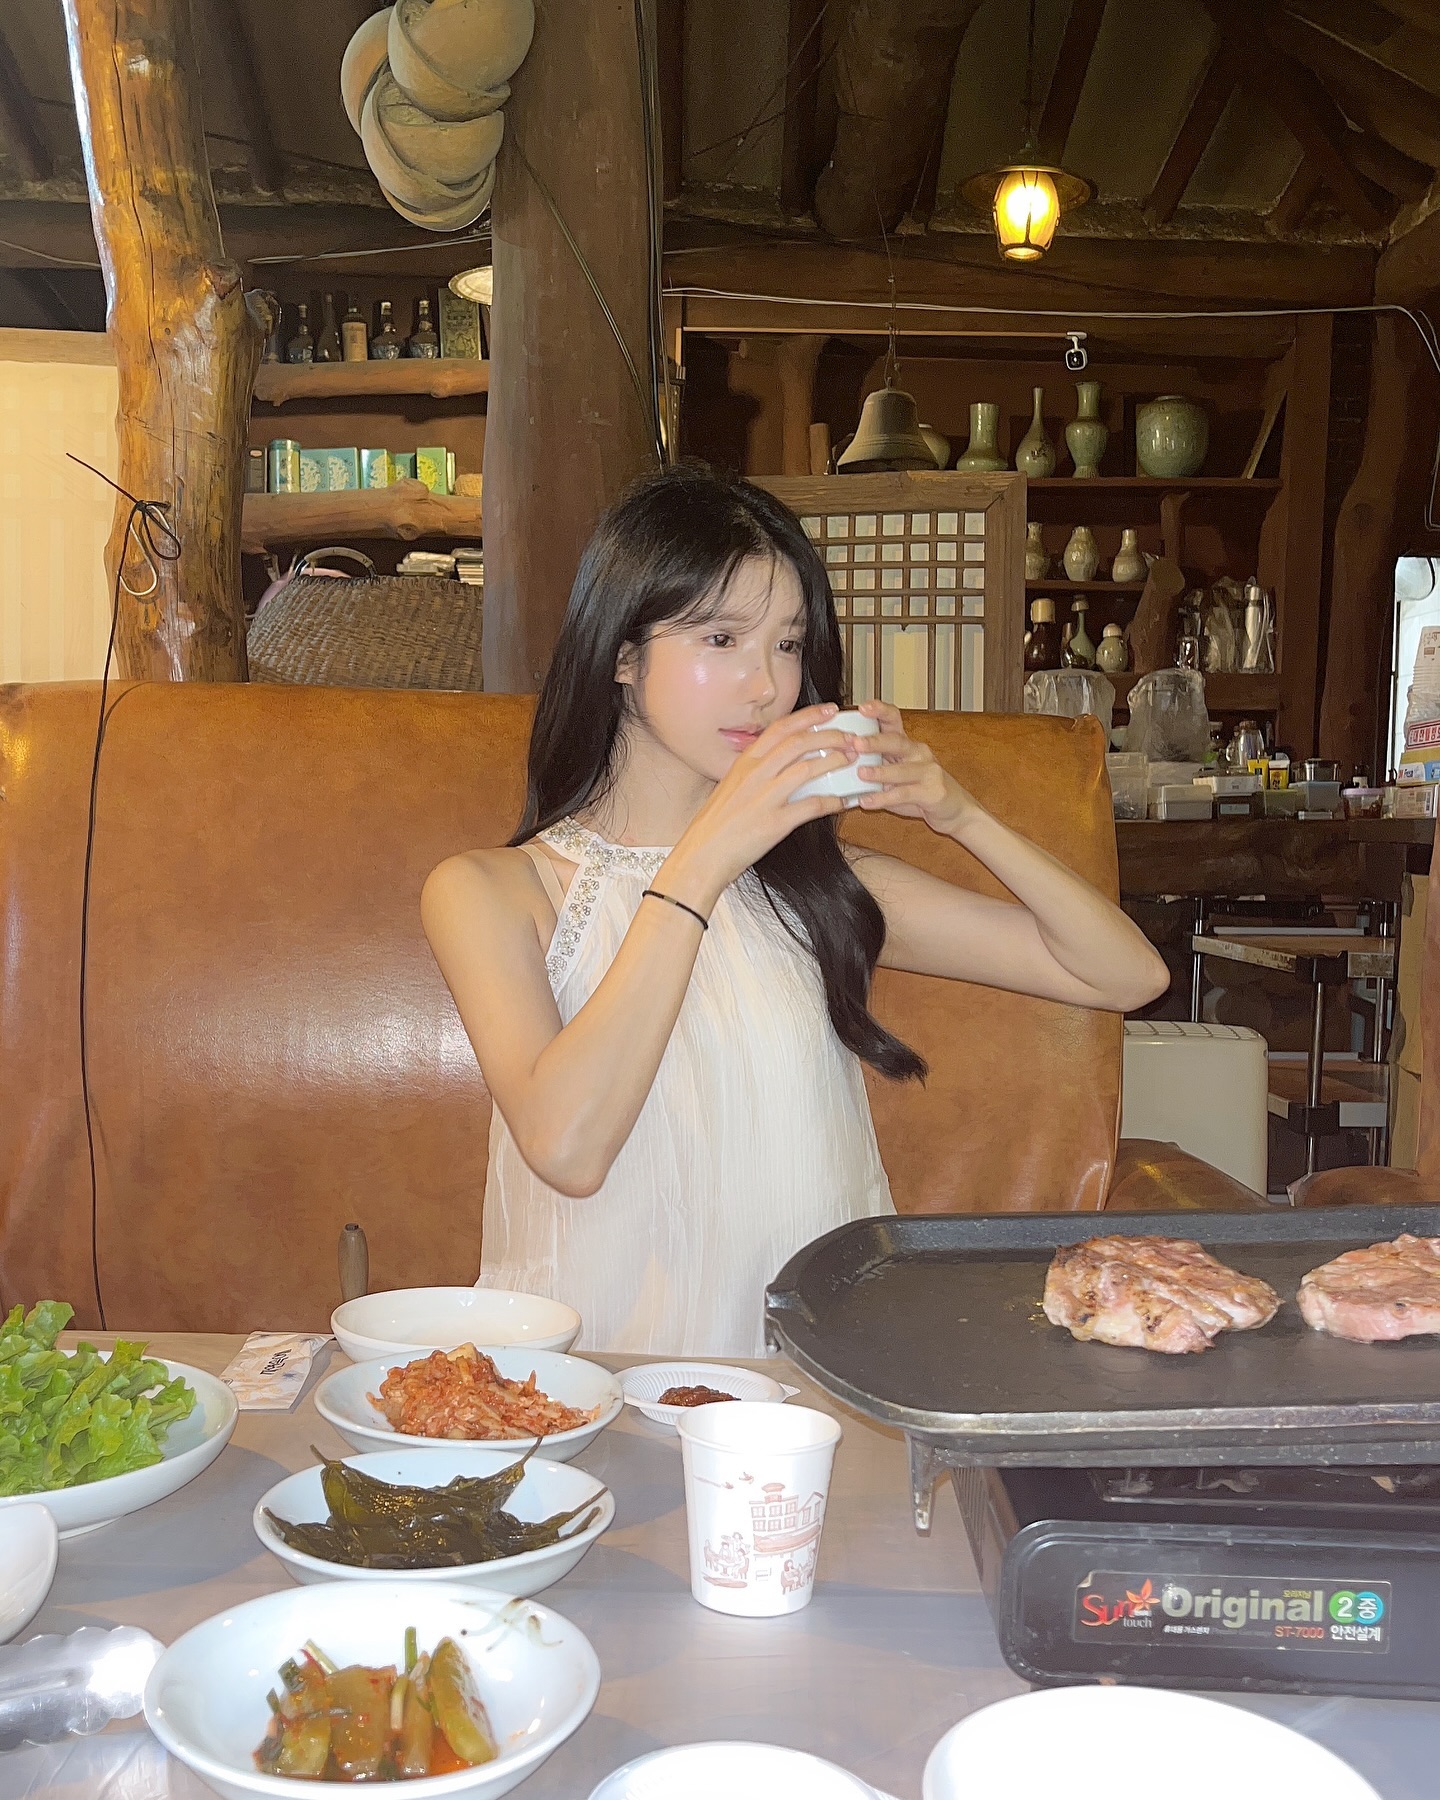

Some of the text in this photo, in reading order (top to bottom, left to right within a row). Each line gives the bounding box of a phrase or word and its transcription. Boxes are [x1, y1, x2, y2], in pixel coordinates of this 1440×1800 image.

[1081, 1594, 1134, 1626] Sun
[1162, 1586, 1323, 1629] Original
[1123, 1617, 1152, 1629] touch
[1275, 1625, 1325, 1639] ST-7000
[1330, 1625, 1381, 1642] 안전설계
